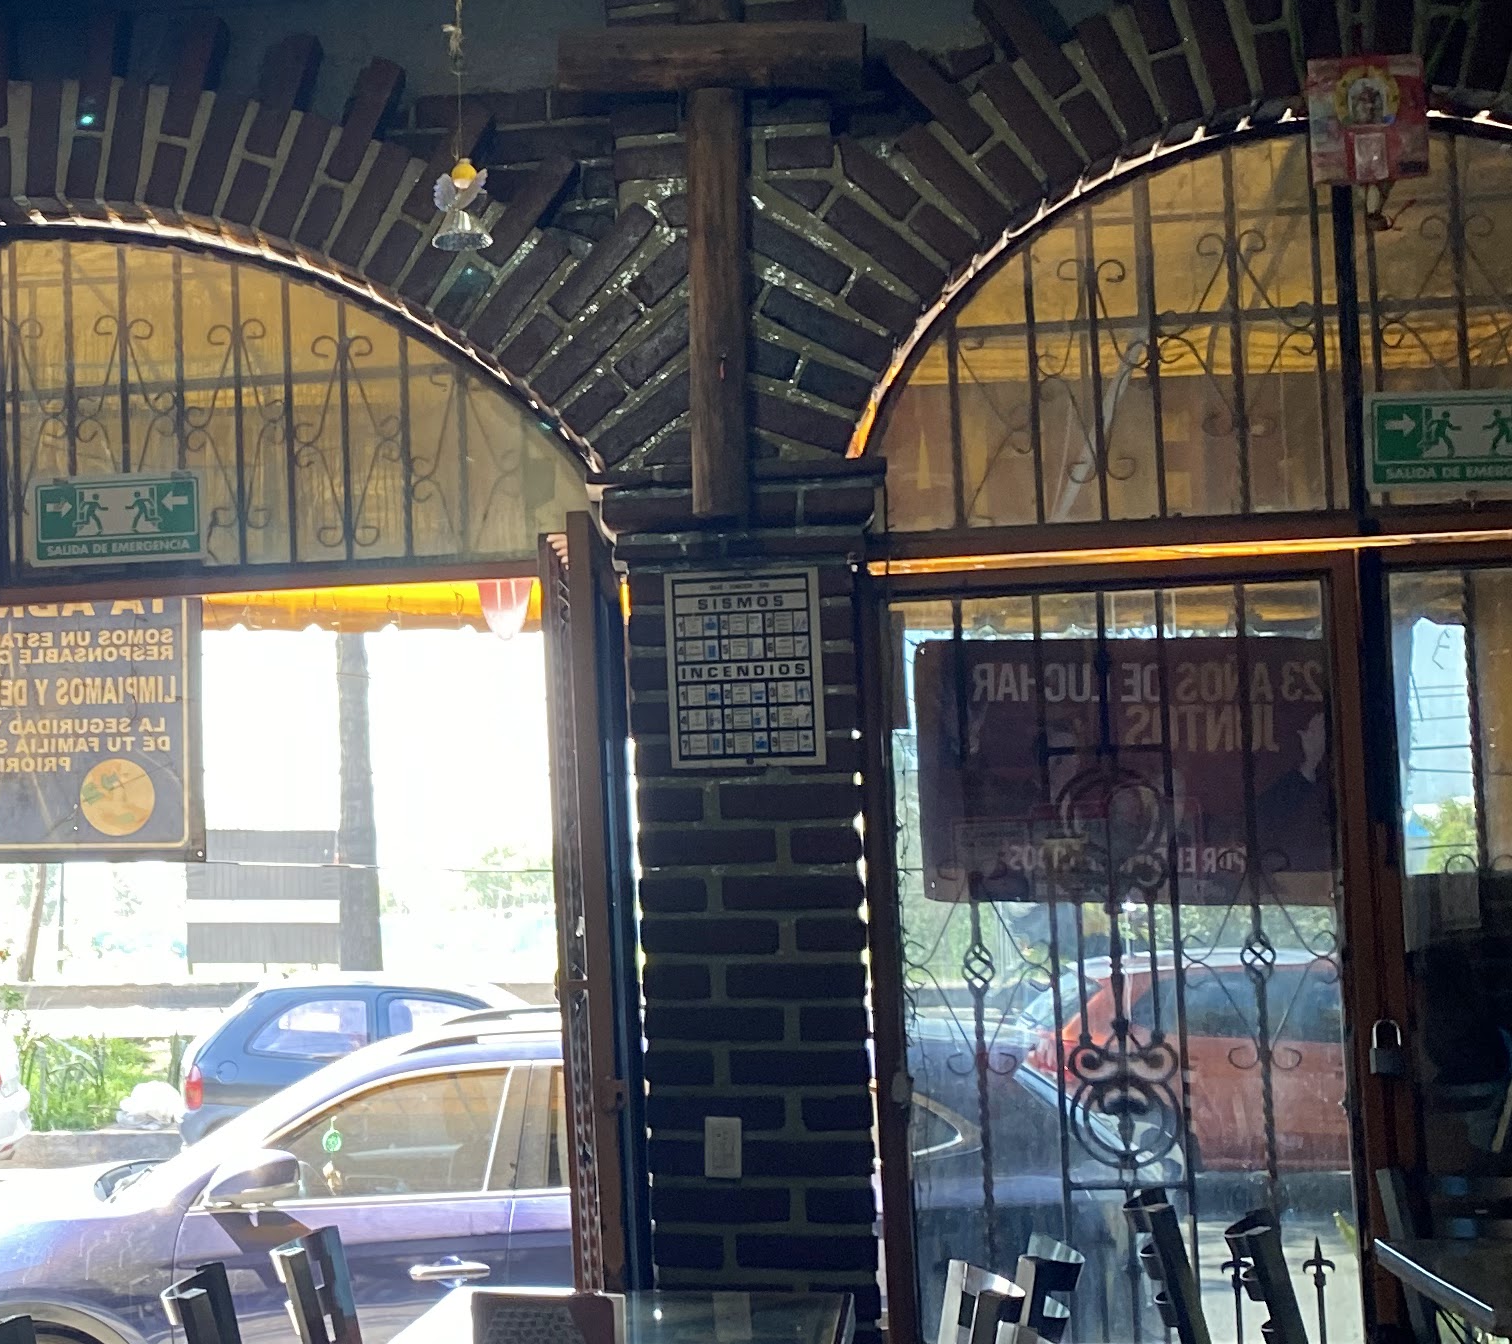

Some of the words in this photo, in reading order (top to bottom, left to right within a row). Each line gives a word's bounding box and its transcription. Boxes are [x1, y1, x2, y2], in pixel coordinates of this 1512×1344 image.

[1385, 466, 1437, 481] SALIDA
[1442, 466, 1460, 479] DE
[46, 544, 89, 556] SALIDA
[92, 542, 108, 554] DE
[111, 538, 191, 554] EMERGENCIA
[698, 594, 784, 611] SISMOS
[681, 663, 806, 679] INCENDIOS
